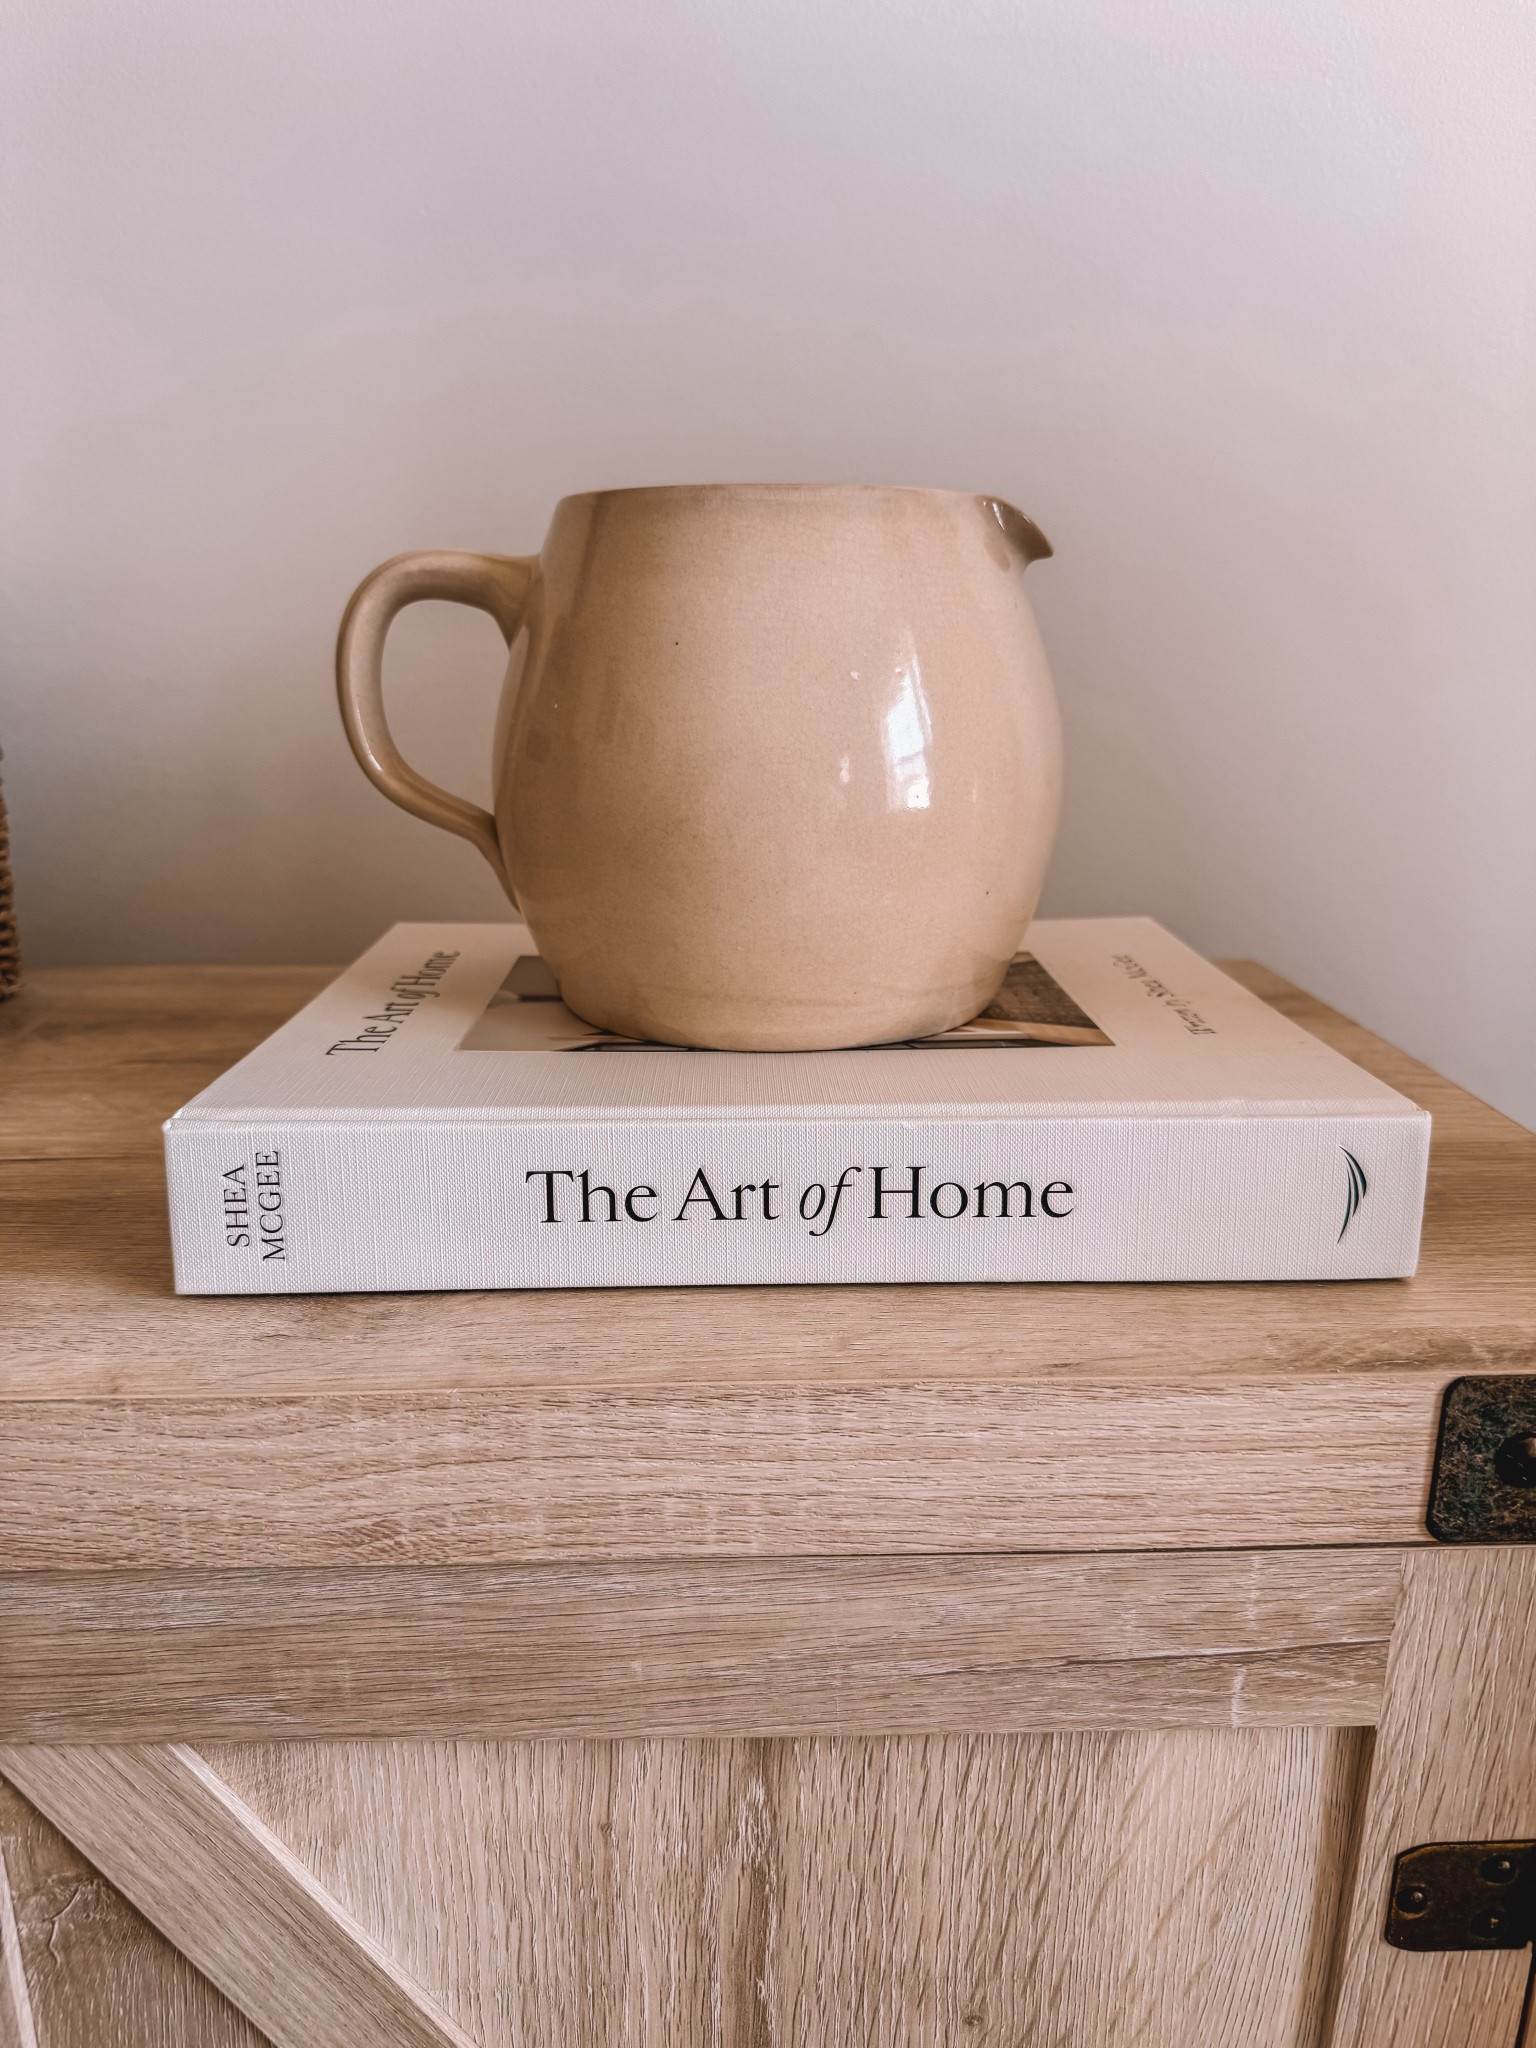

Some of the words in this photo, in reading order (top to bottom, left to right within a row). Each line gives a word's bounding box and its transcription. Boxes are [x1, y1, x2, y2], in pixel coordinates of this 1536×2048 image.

[394, 950, 461, 987] Home
[390, 985, 441, 1001] of
[362, 1001, 420, 1024] Art
[325, 1025, 398, 1056] The
[221, 1163, 250, 1248] SHEA
[255, 1150, 285, 1262] MCGEE
[525, 1168, 659, 1223] The
[671, 1167, 780, 1221] Art
[799, 1166, 862, 1236] of
[867, 1166, 1075, 1219] Home
